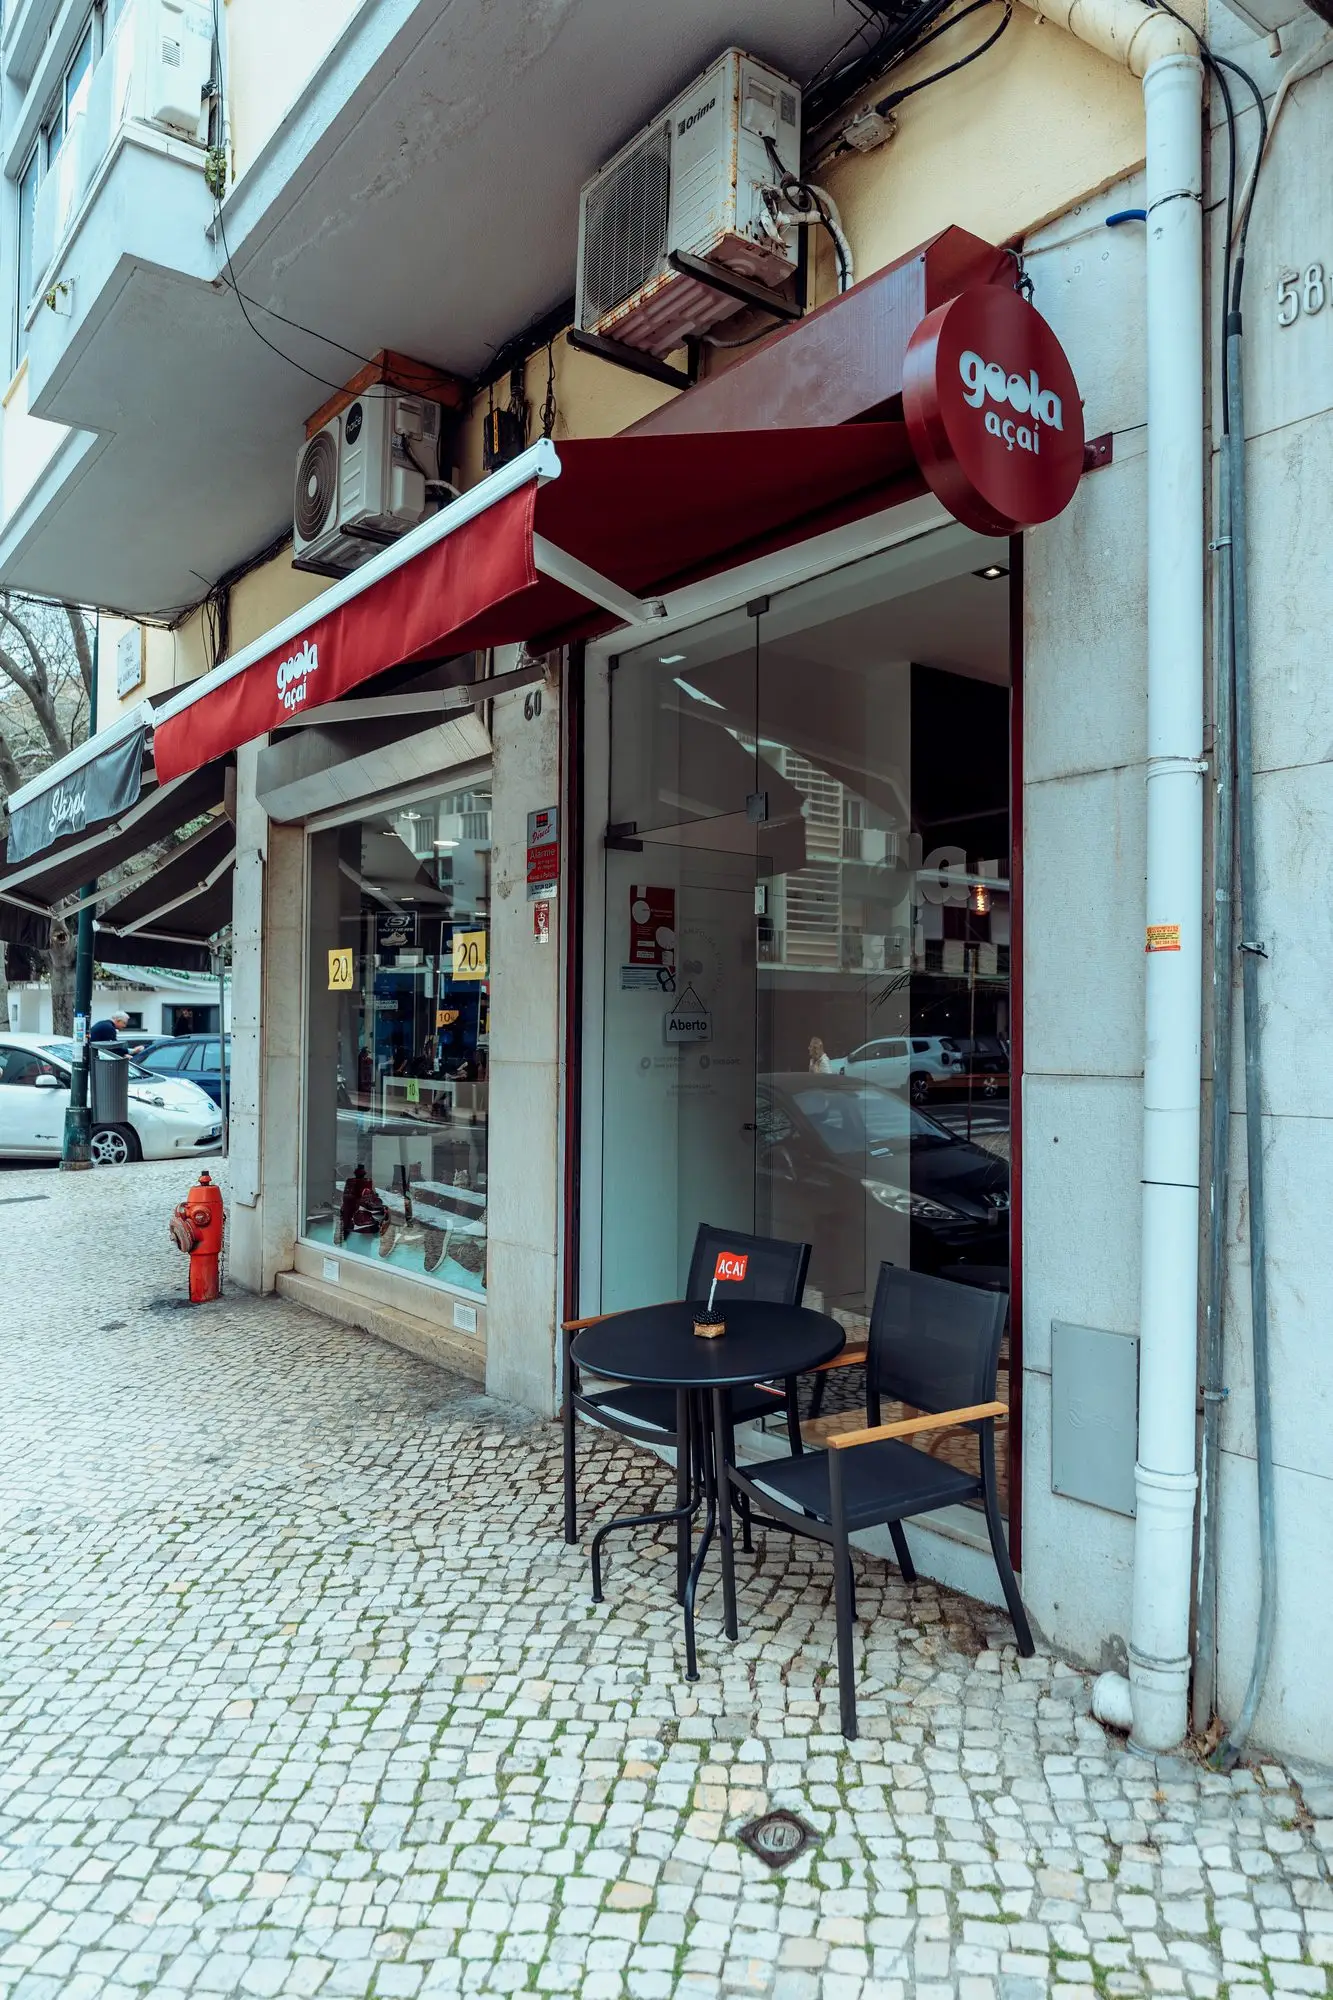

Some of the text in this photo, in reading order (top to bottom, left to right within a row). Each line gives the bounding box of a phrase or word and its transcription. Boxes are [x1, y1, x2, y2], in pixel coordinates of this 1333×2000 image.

[686, 97, 716, 130] Orima
[1277, 263, 1333, 328] 58
[959, 350, 1064, 431] goola
[276, 640, 319, 700] goola
[524, 690, 542, 721] 60
[669, 1019, 707, 1031] Aberto
